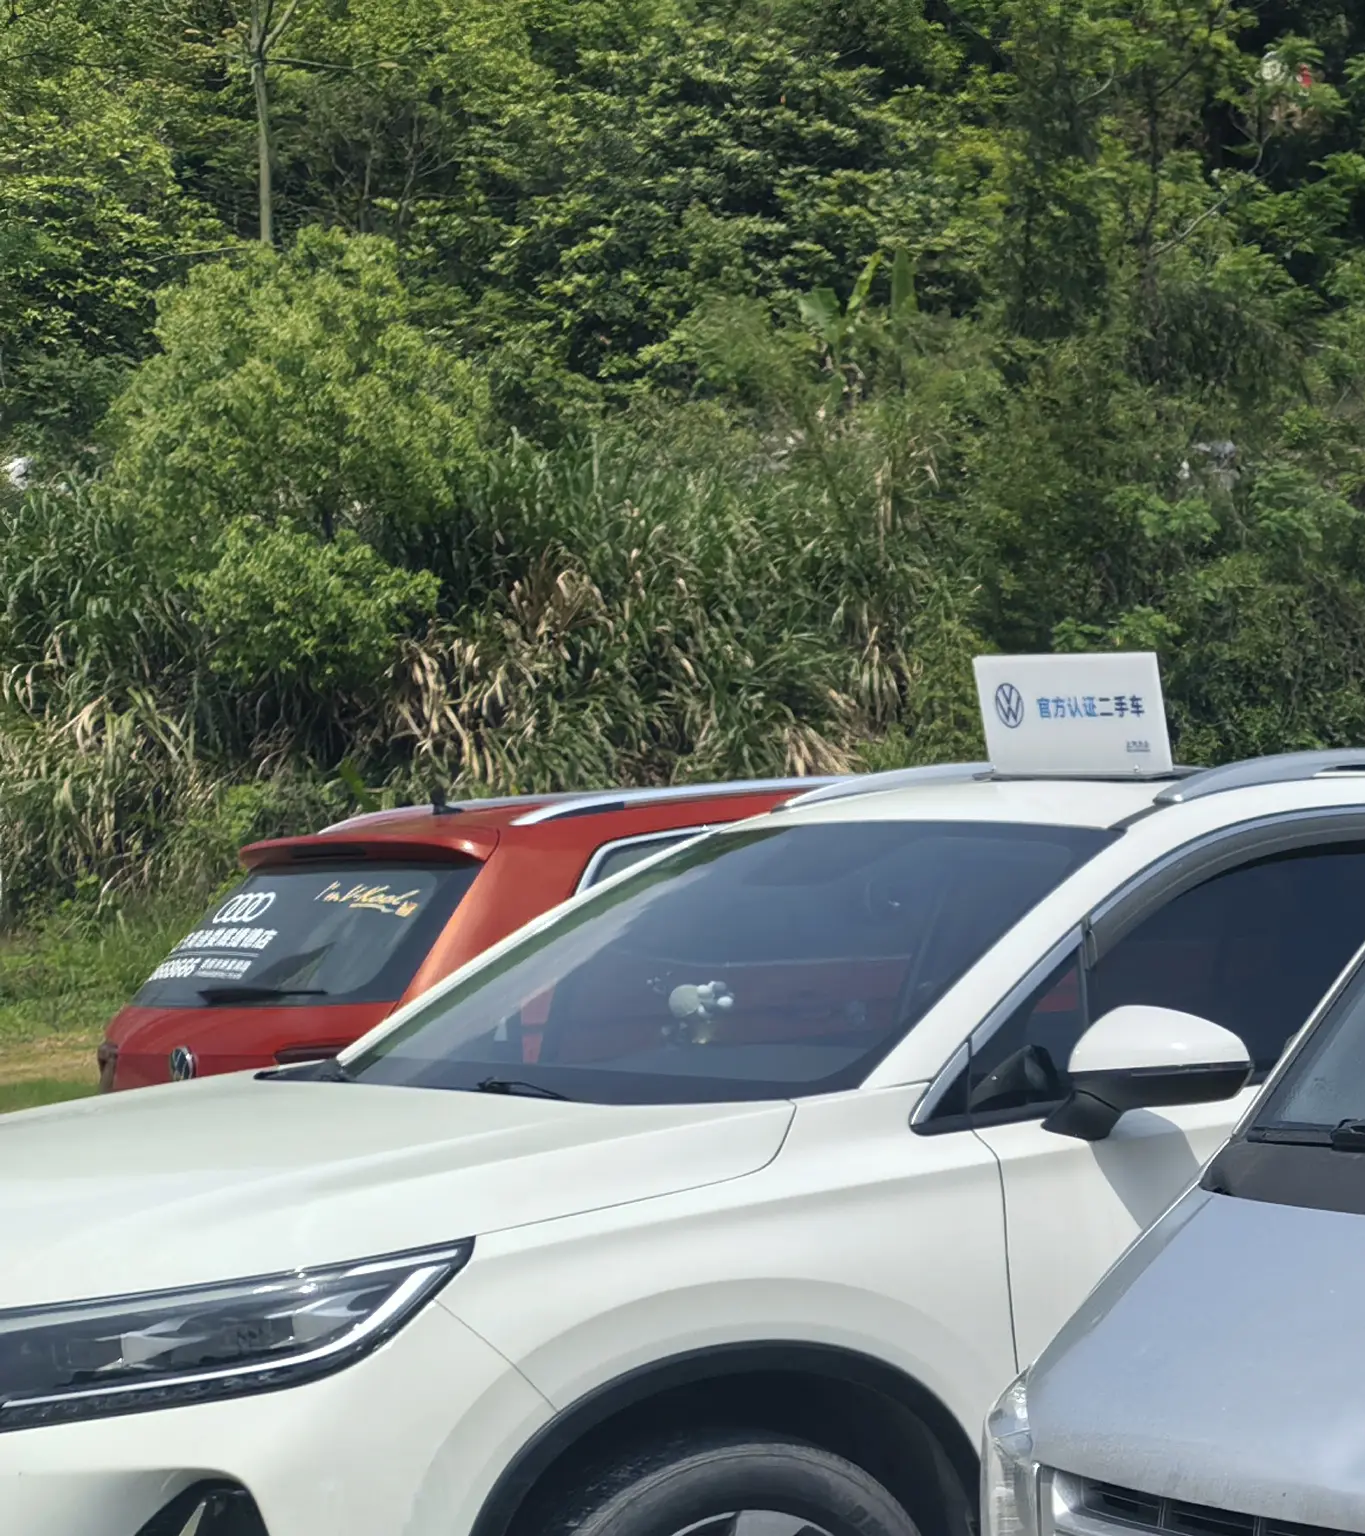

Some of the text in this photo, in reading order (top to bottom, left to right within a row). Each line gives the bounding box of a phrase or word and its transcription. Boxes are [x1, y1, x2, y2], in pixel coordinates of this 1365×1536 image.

[1036, 695, 1146, 718] 官方认证二手车
